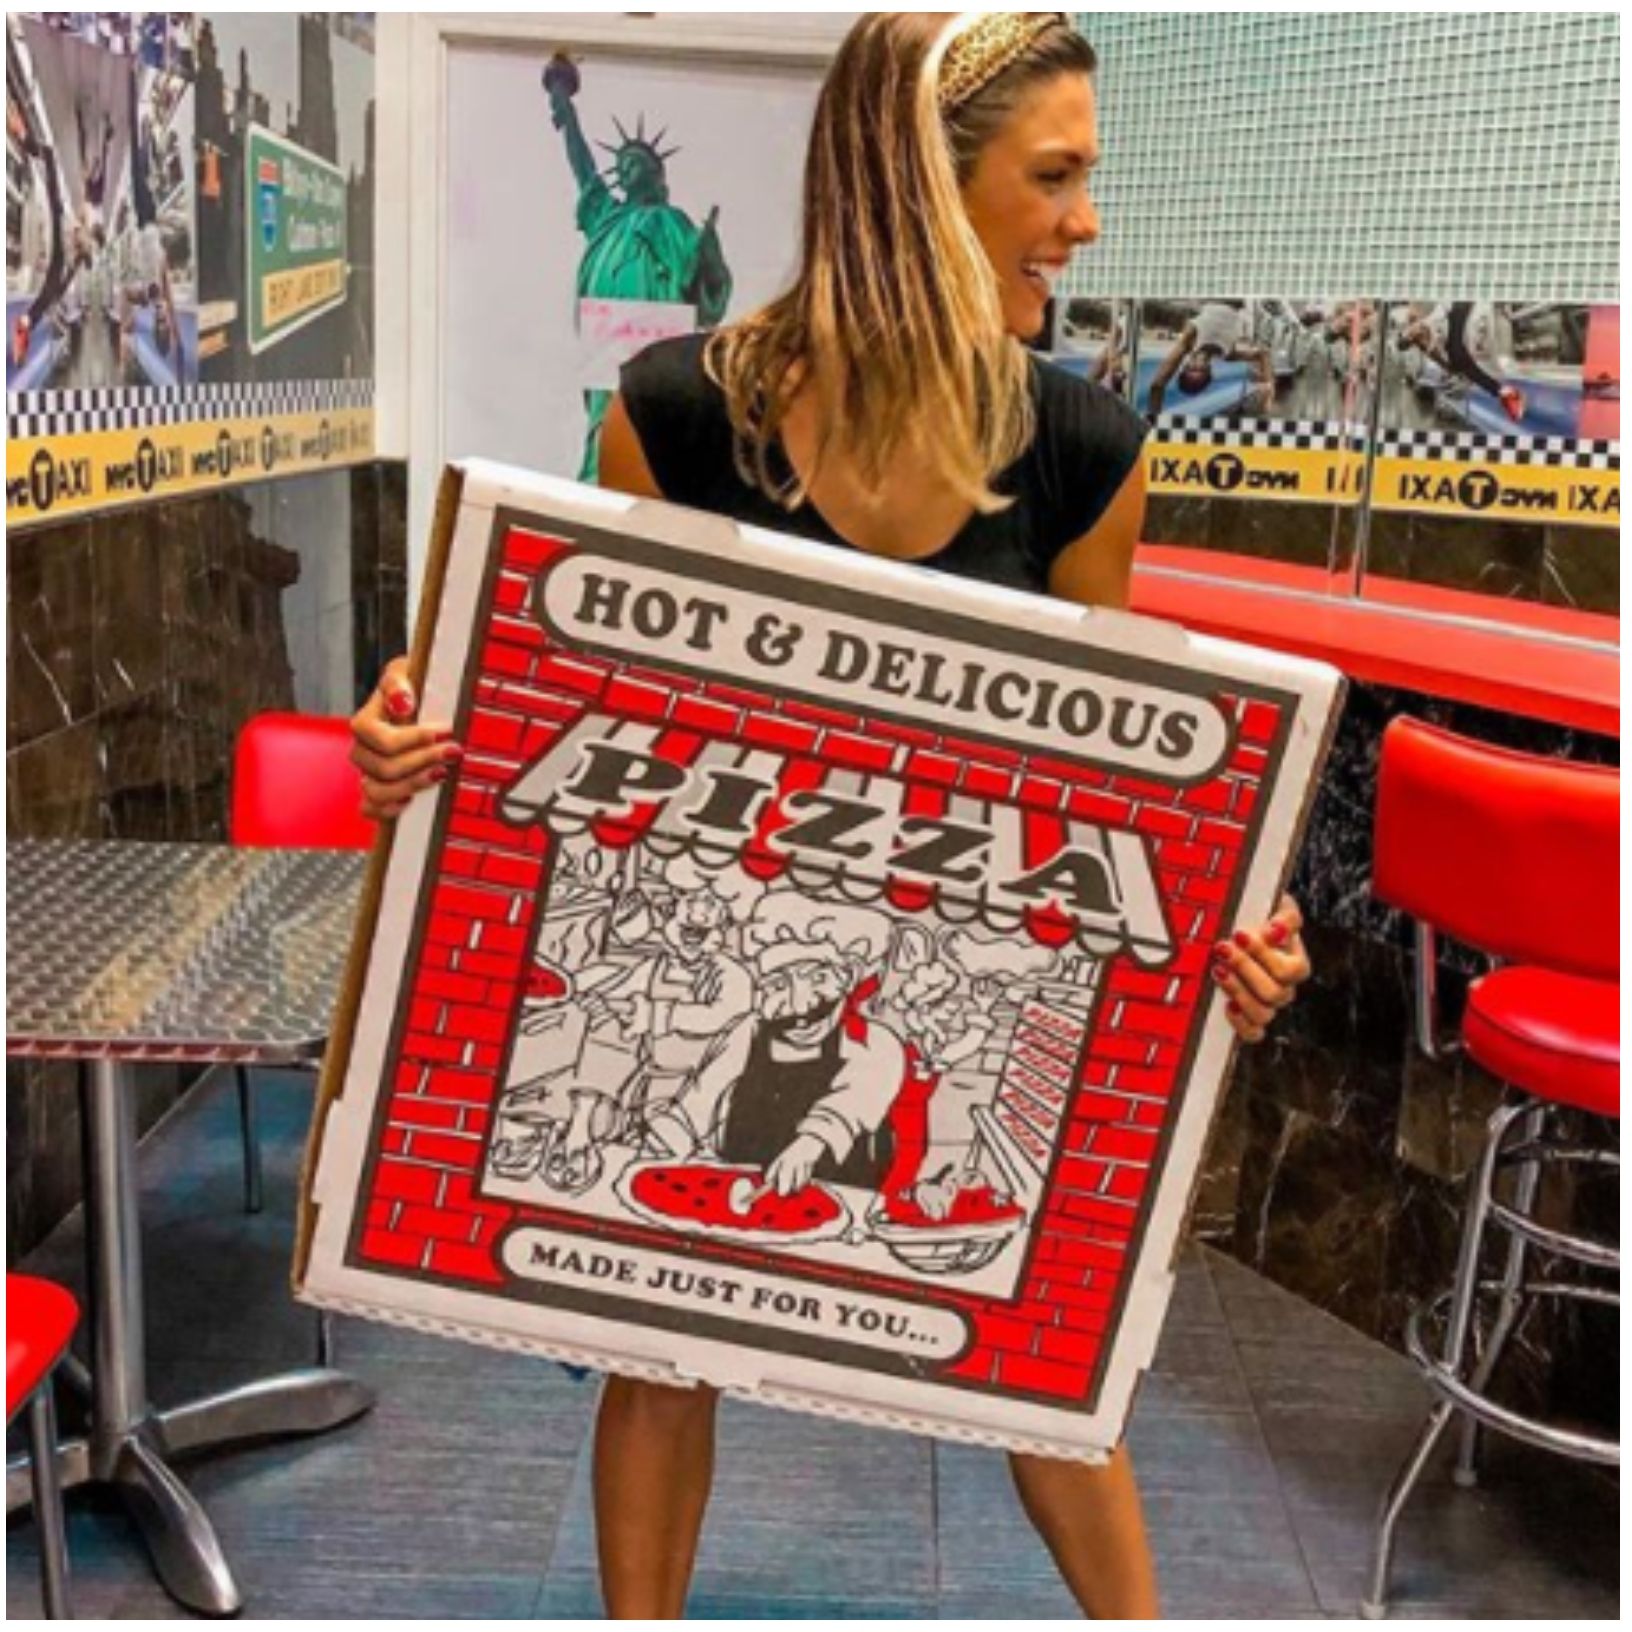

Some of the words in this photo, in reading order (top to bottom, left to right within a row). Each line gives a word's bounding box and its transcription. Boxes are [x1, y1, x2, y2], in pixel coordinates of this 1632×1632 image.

[31, 450, 91, 511] TAXI
[573, 573, 729, 650] HOT
[745, 613, 805, 667] &
[818, 630, 1200, 760] DELICIOUS
[567, 742, 1123, 914] PIZZA
[529, 1242, 638, 1284] MADE
[646, 1266, 744, 1302] JUST
[749, 1287, 821, 1321] FOR
[835, 1303, 939, 1346] YOU...
